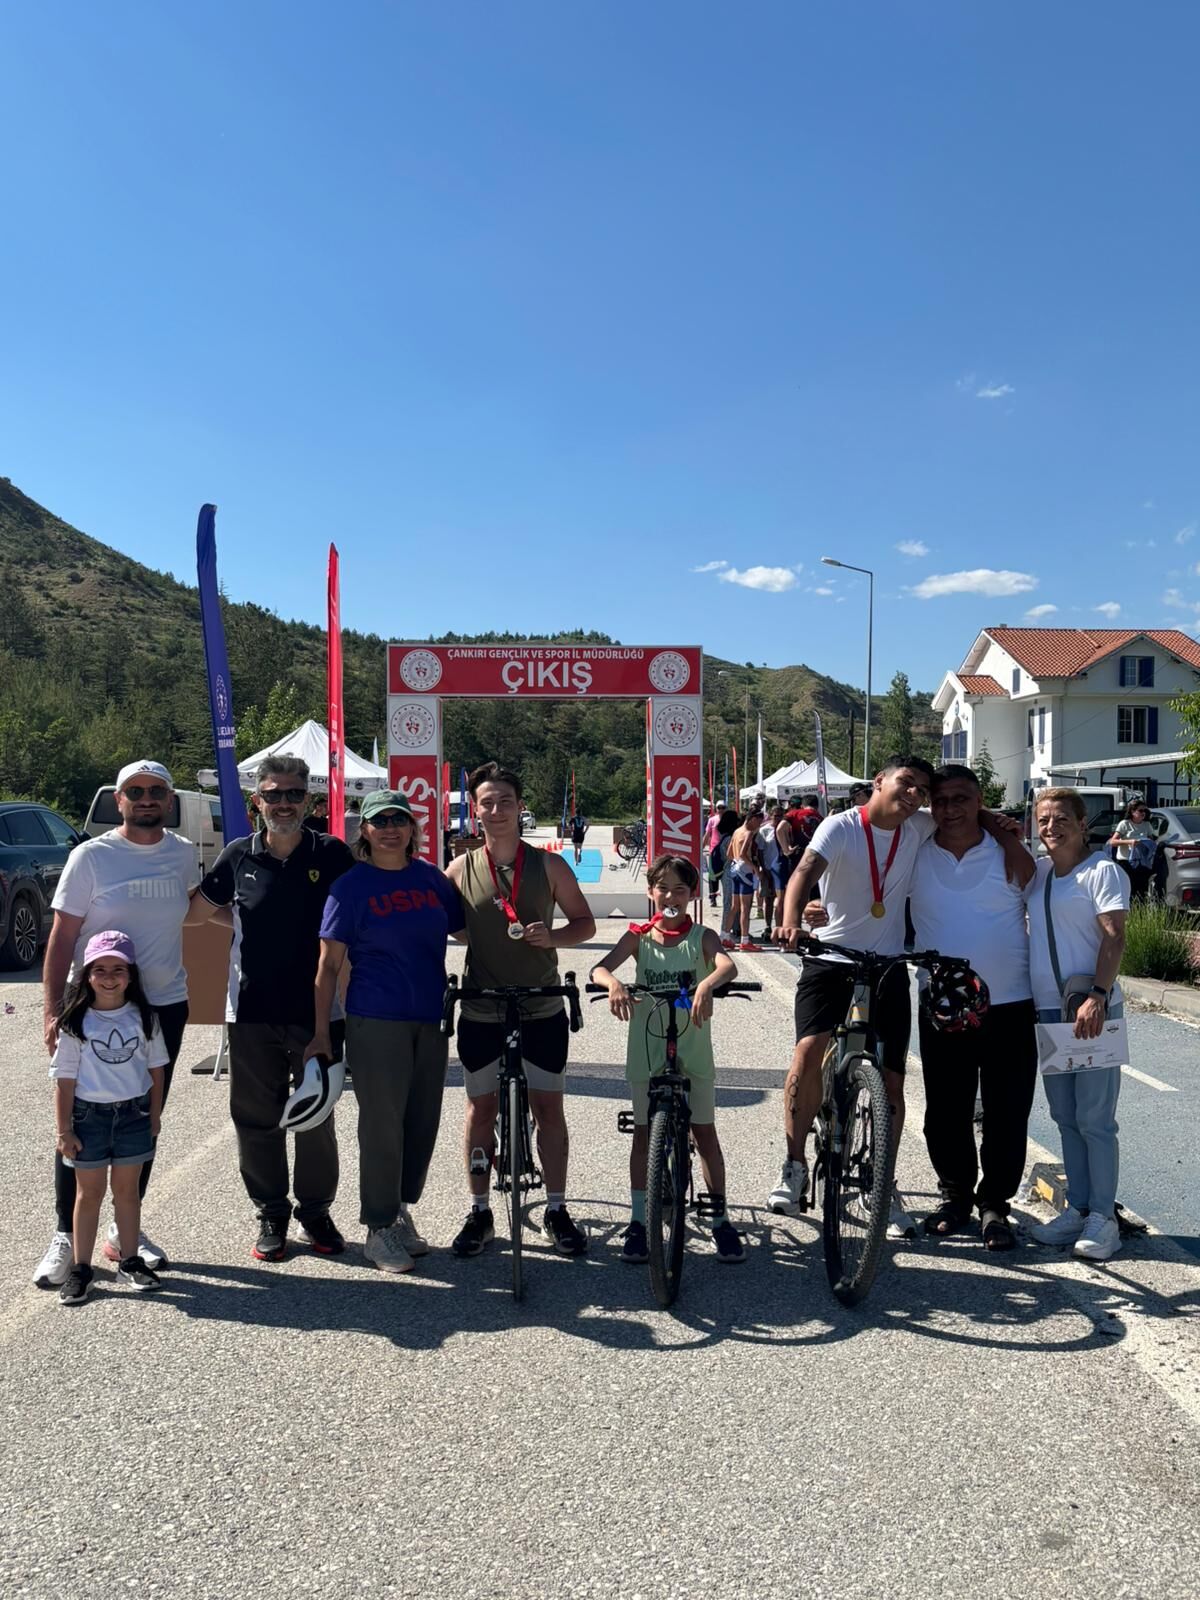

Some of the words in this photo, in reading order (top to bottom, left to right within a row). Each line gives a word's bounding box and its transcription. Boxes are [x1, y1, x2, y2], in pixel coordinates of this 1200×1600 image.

[447, 649, 487, 660] ÇANKIRI
[488, 649, 529, 660] GENÇLİK
[531, 649, 543, 659] VE
[544, 649, 571, 659] SPOR
[572, 648, 581, 659] İL
[582, 648, 645, 660] MÜDÜRLÜĞÜ
[501, 661, 593, 694] ÇIKIŞ
[661, 776, 700, 857] IKIŞ
